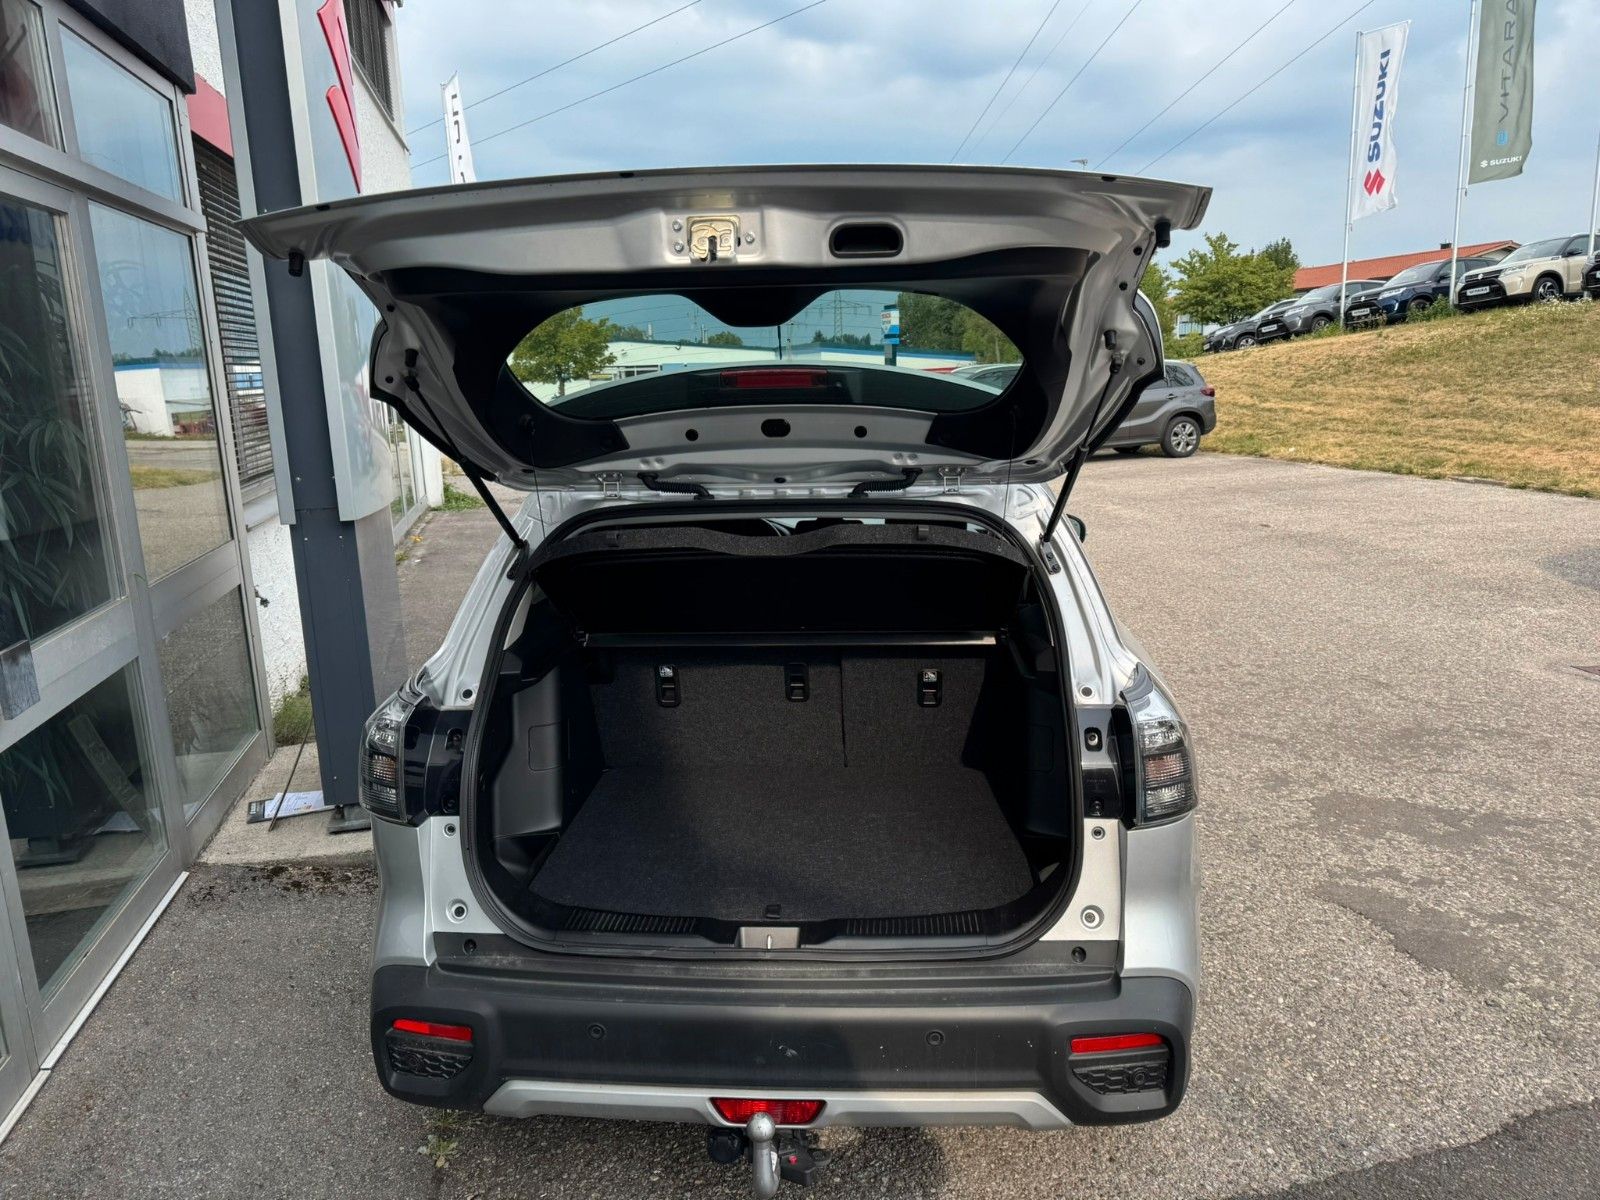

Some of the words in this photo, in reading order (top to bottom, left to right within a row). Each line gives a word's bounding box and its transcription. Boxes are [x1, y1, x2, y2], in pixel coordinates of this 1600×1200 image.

[1368, 49, 1391, 163] SUZUKI
[1499, 0, 1518, 123] VITARA
[1490, 155, 1523, 166] SUZUKI
